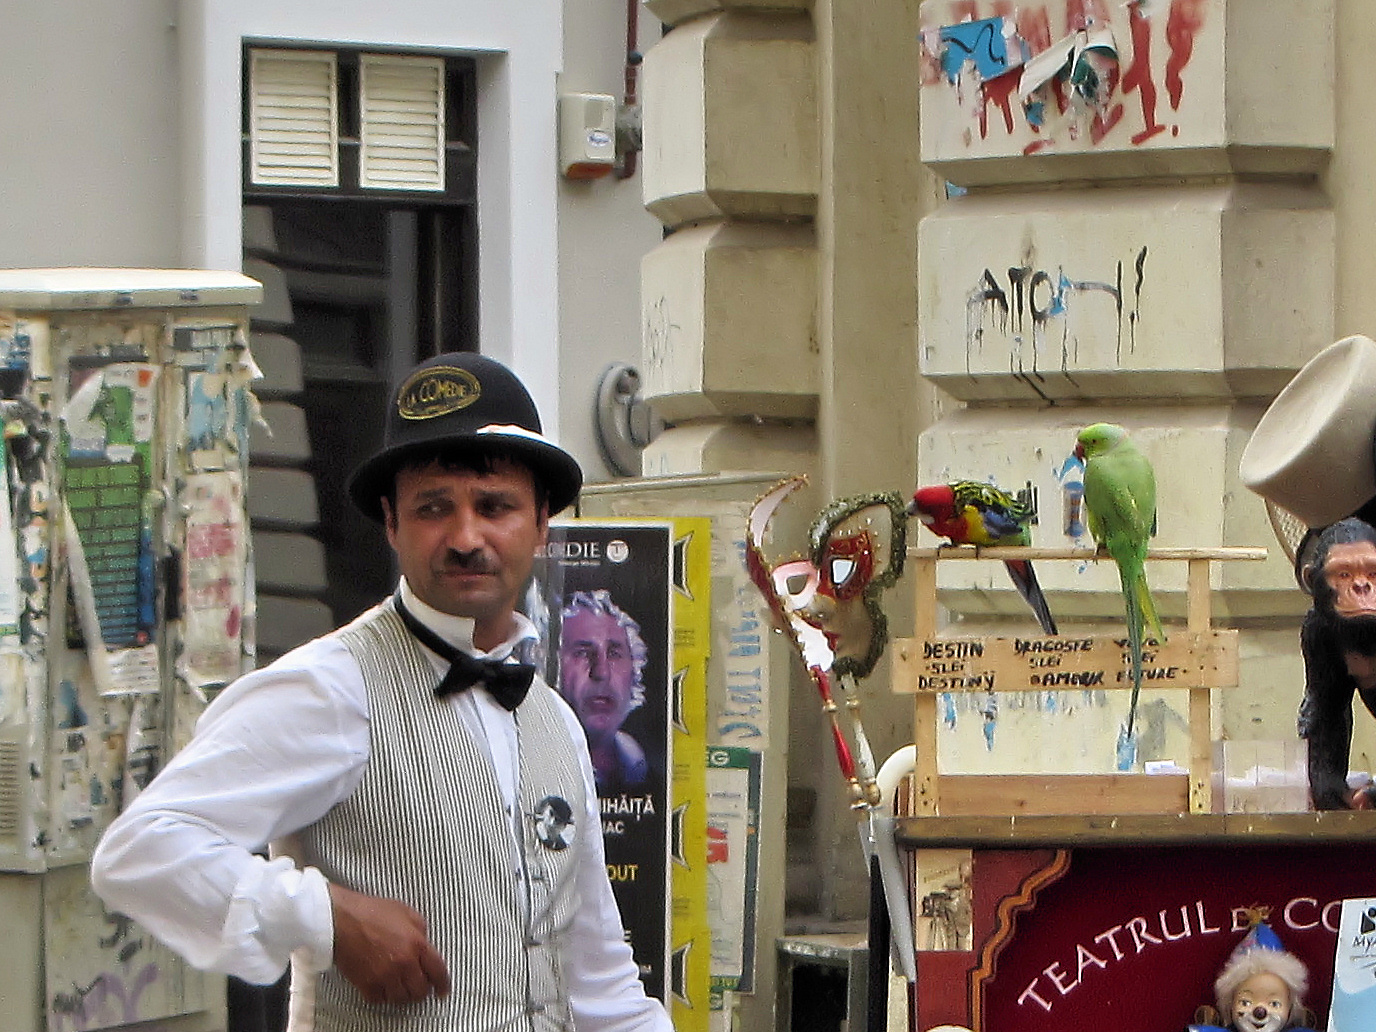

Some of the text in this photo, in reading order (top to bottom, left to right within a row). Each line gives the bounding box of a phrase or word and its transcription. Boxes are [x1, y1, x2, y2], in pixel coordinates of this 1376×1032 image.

[923, 641, 984, 659] DESTIN
[1014, 637, 1093, 656] DRAGOSTE
[918, 672, 995, 692] DESTINY
[1017, 900, 1220, 1011] TEATRUL
